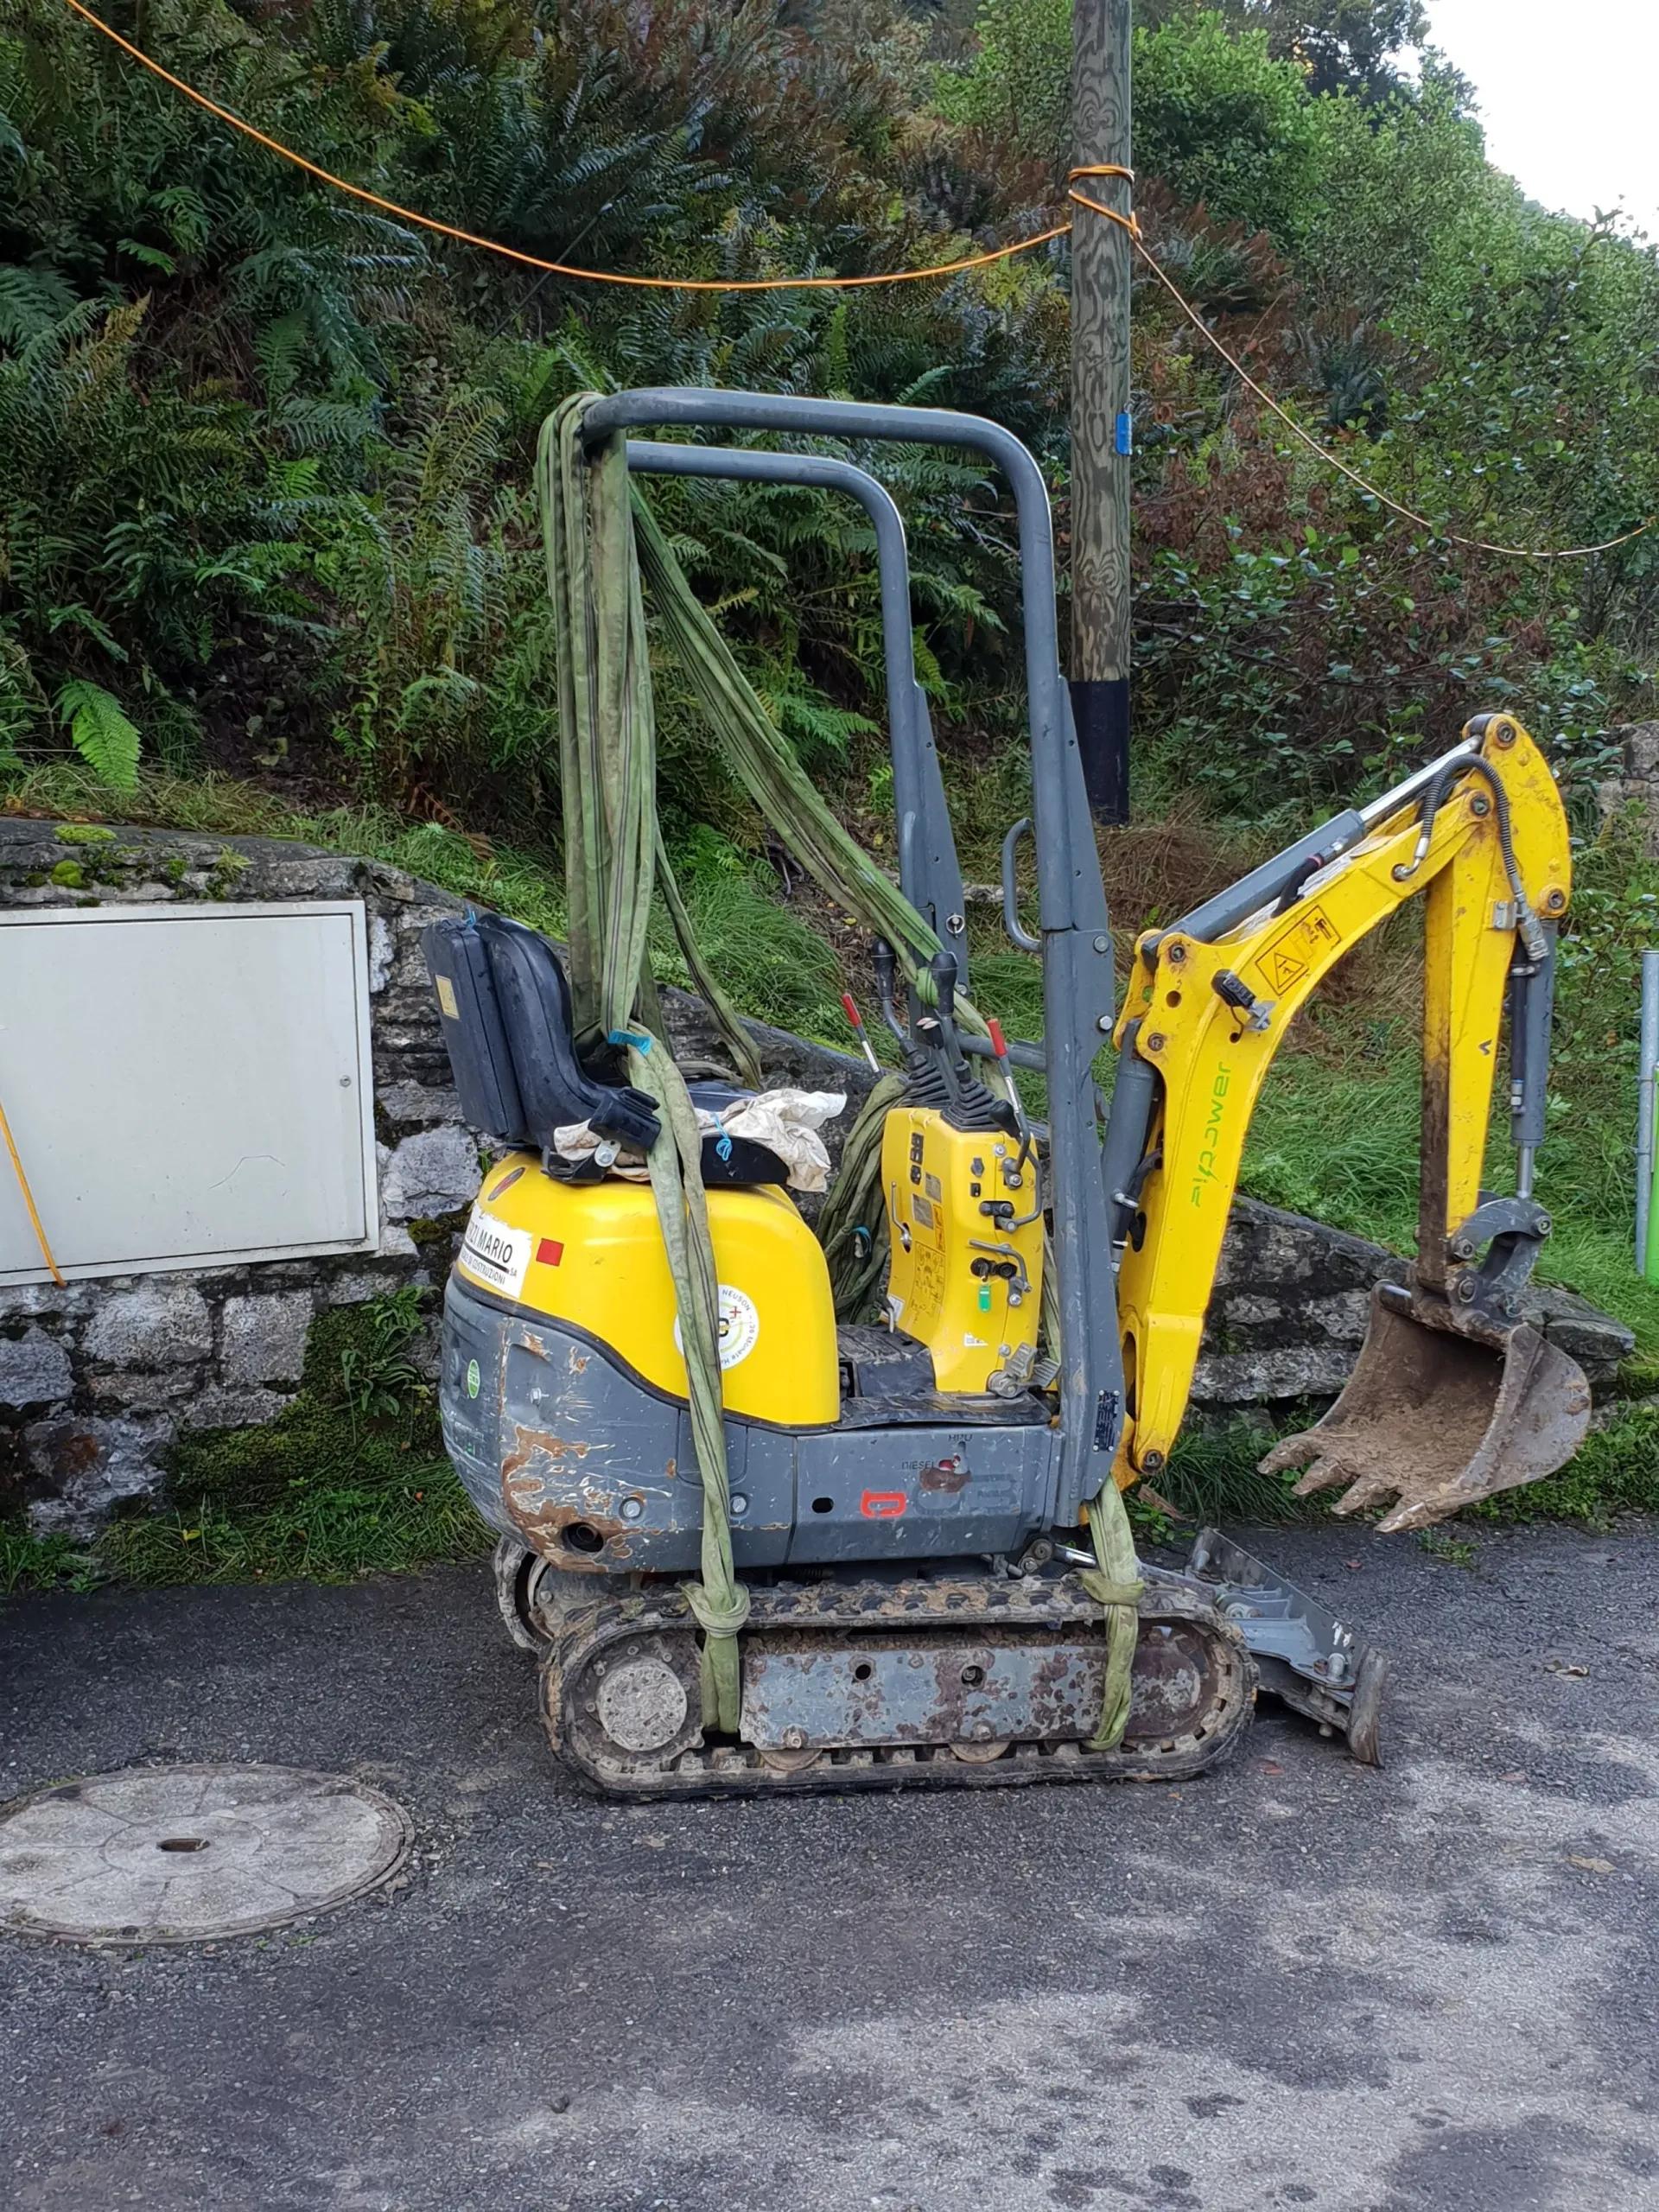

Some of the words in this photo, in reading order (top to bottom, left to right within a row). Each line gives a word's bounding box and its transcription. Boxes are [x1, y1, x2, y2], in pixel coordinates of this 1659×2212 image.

[477, 1230, 513, 1263] MARIO
[722, 1289, 751, 1310] NEUSON
[901, 1461, 938, 1471] DIESEL
